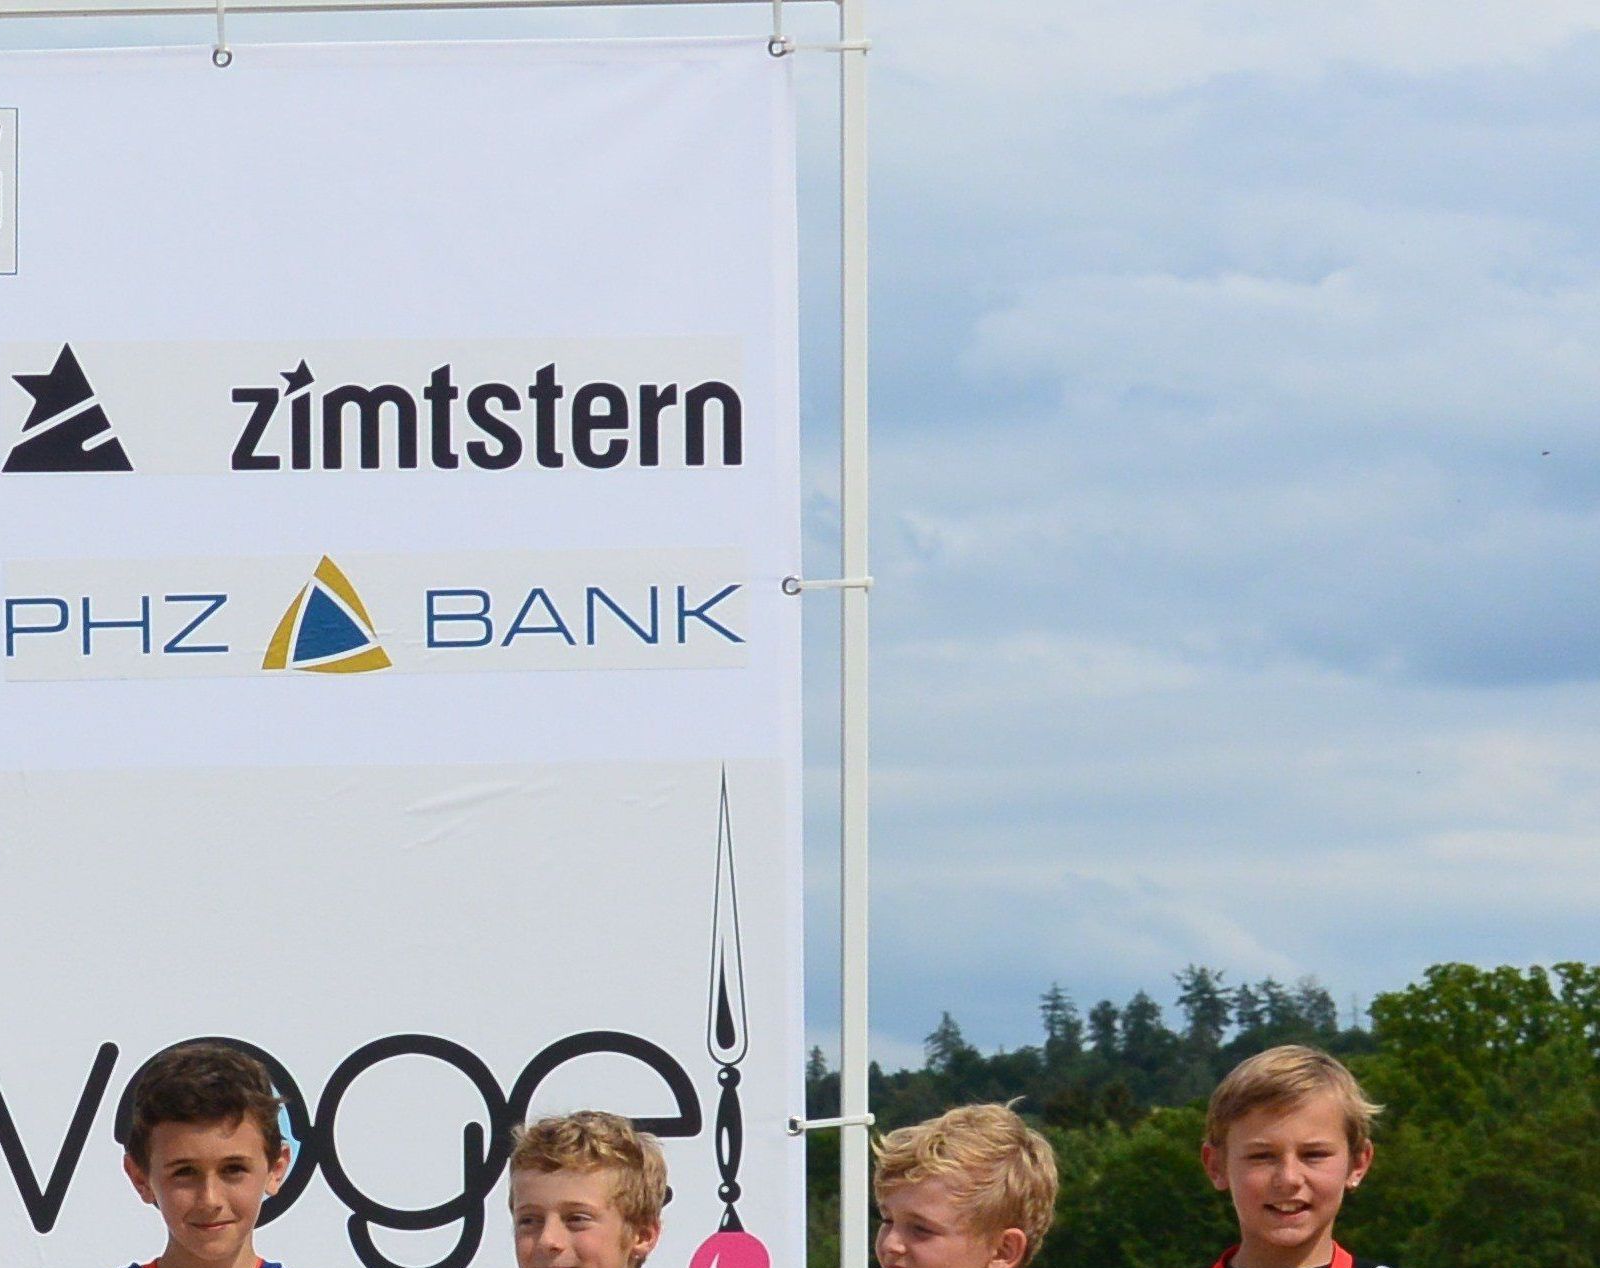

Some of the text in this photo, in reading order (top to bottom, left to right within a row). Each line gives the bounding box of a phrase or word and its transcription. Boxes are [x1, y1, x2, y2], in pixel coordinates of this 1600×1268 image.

[230, 359, 744, 470] zimtstern
[6, 582, 747, 657] PHZ BANK
